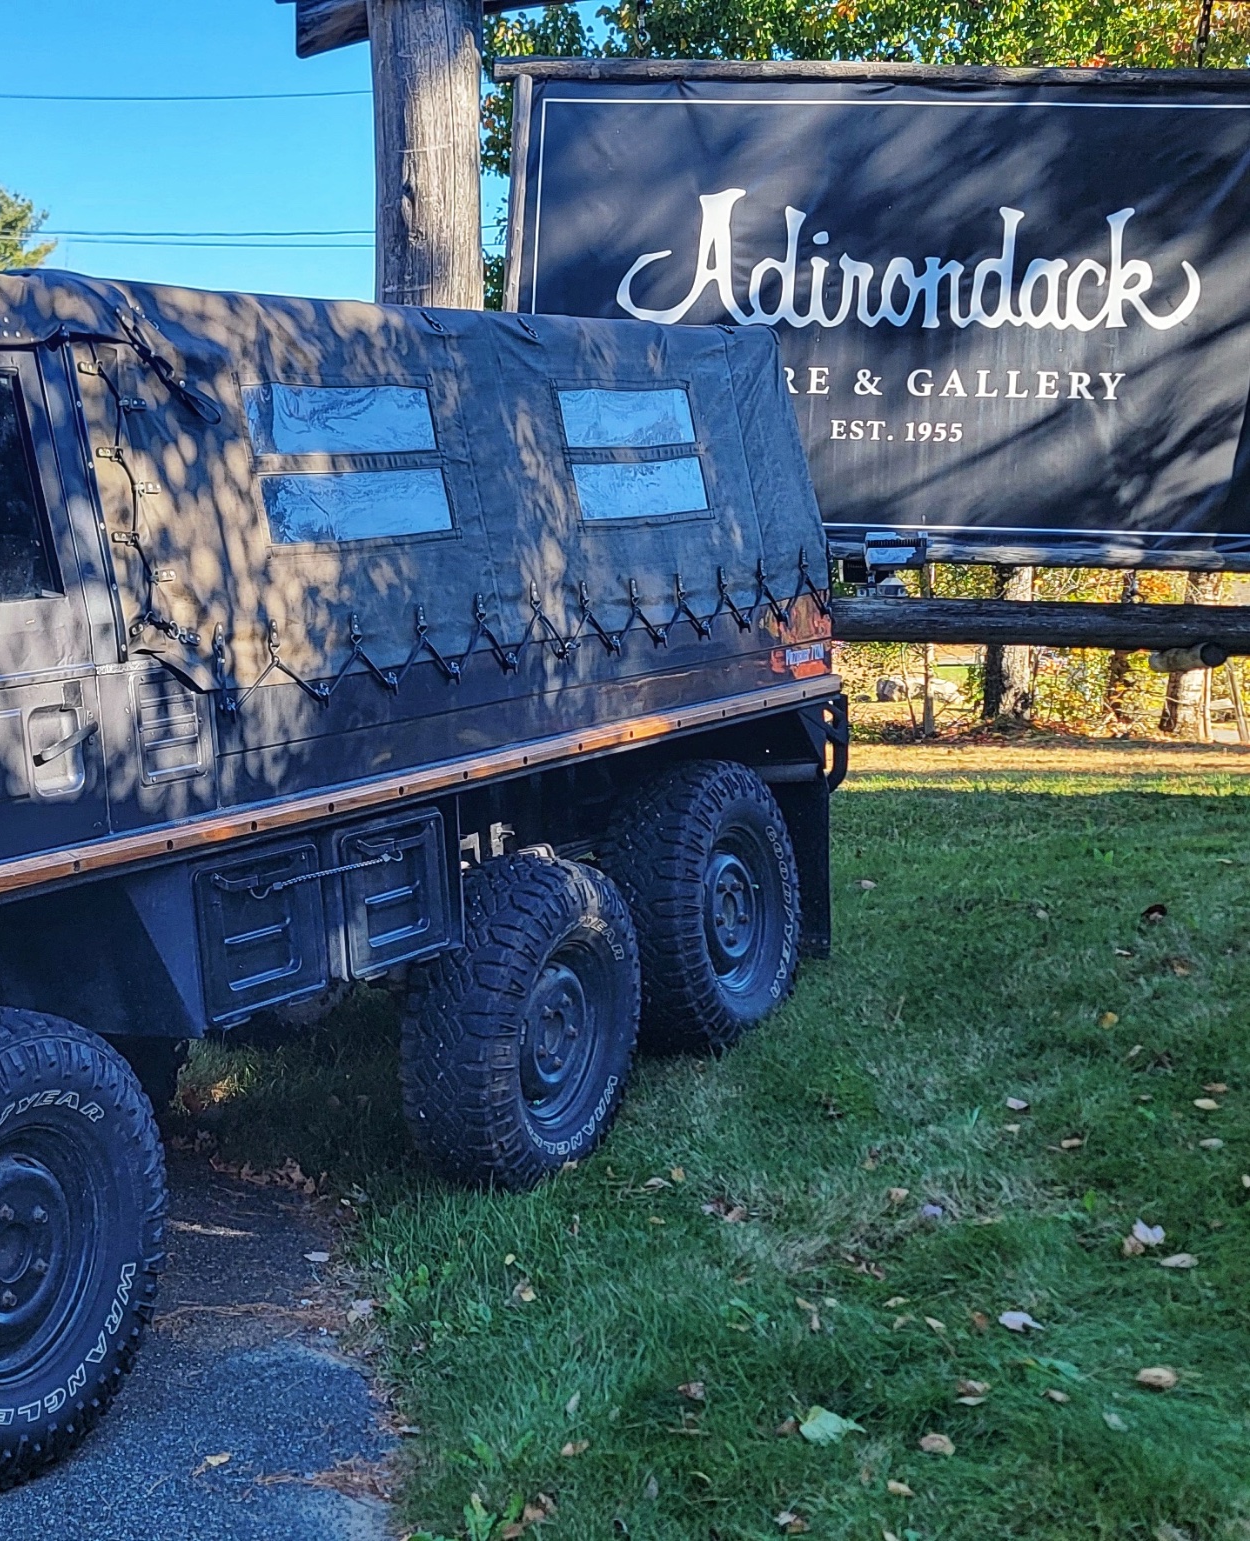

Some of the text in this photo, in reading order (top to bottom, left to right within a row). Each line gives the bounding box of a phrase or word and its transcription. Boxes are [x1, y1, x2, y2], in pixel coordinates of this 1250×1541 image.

[616, 188, 1201, 331] Adirondack
[853, 369, 883, 396] &
[907, 369, 1126, 401] GALLERY
[830, 419, 963, 442] EST. 1955
[765, 825, 795, 999] GOODYEAR
